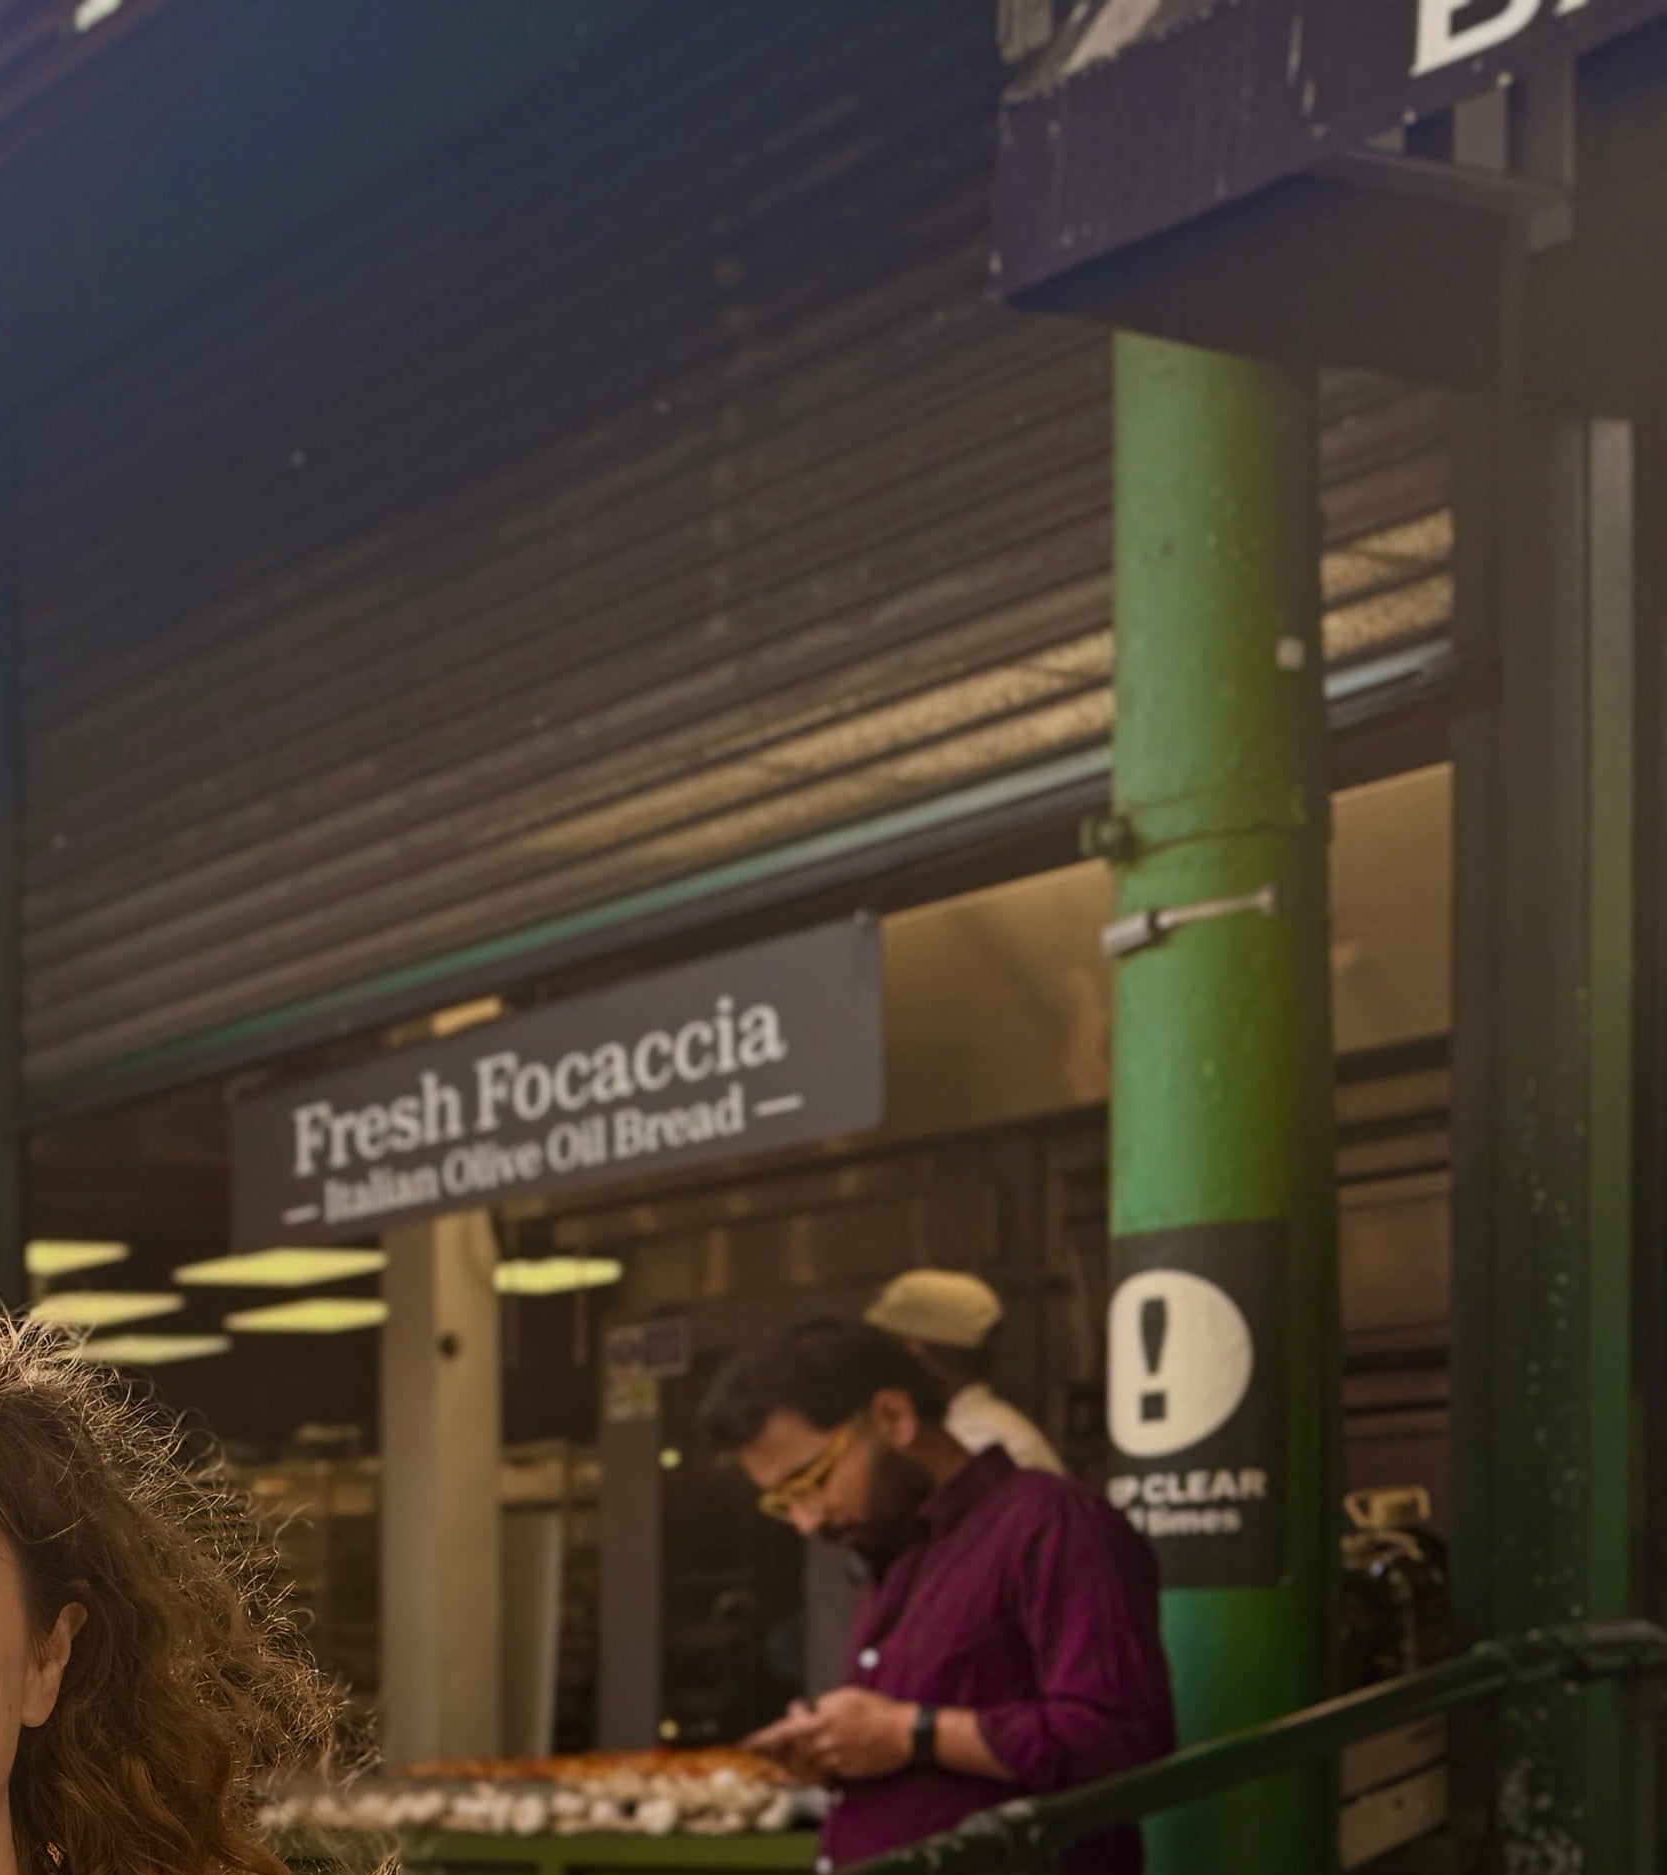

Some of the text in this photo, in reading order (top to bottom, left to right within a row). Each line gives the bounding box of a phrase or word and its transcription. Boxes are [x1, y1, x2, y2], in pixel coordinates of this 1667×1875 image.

[293, 996, 788, 1178] Fresh Focaccia
[322, 1081, 746, 1225] Italian Olive Oil Bread
[1142, 1467, 1267, 1506] CLEAR
